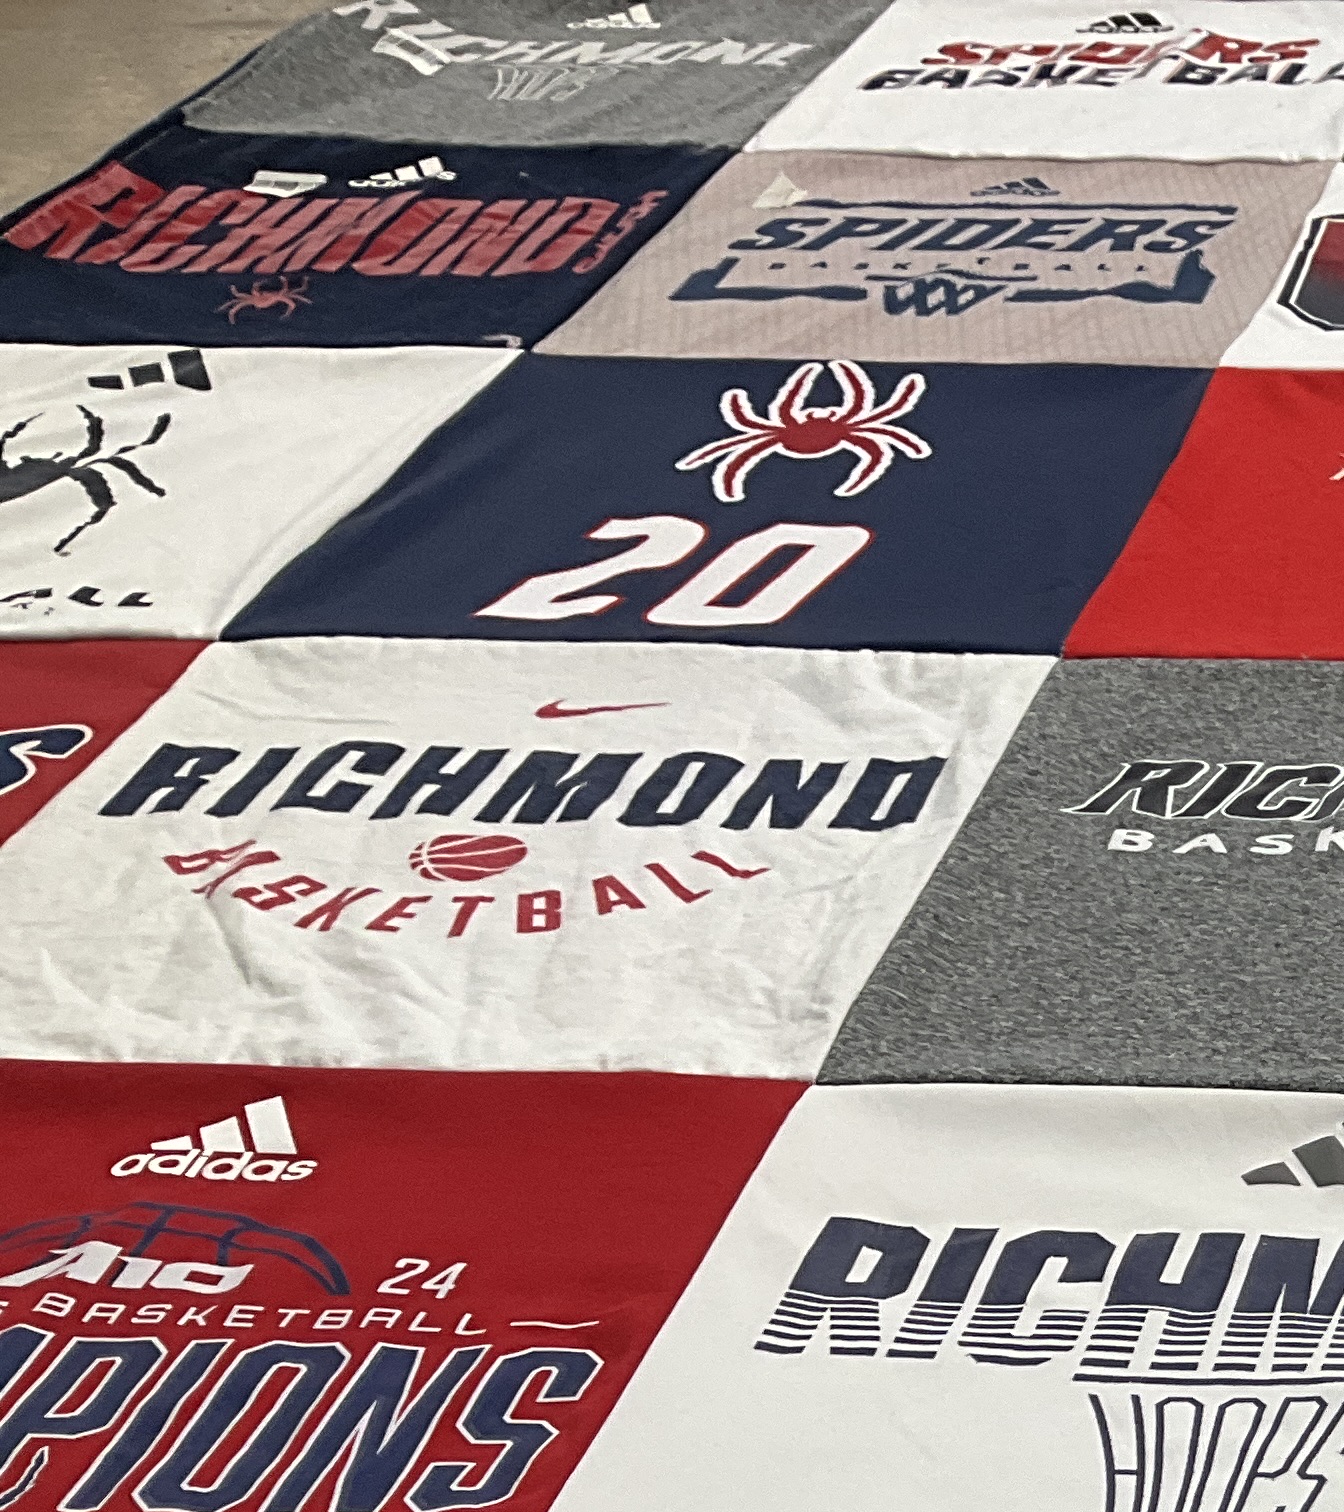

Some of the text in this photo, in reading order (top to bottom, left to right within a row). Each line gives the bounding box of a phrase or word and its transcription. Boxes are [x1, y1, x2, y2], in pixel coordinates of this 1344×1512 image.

[729, 217, 1237, 252] SPIDERS
[470, 514, 875, 626] 20
[98, 740, 949, 831] RICHMOND
[110, 1147, 318, 1182] adidas
[377, 1258, 468, 1299] 24
[32, 1292, 487, 1335] BASKETBALL
